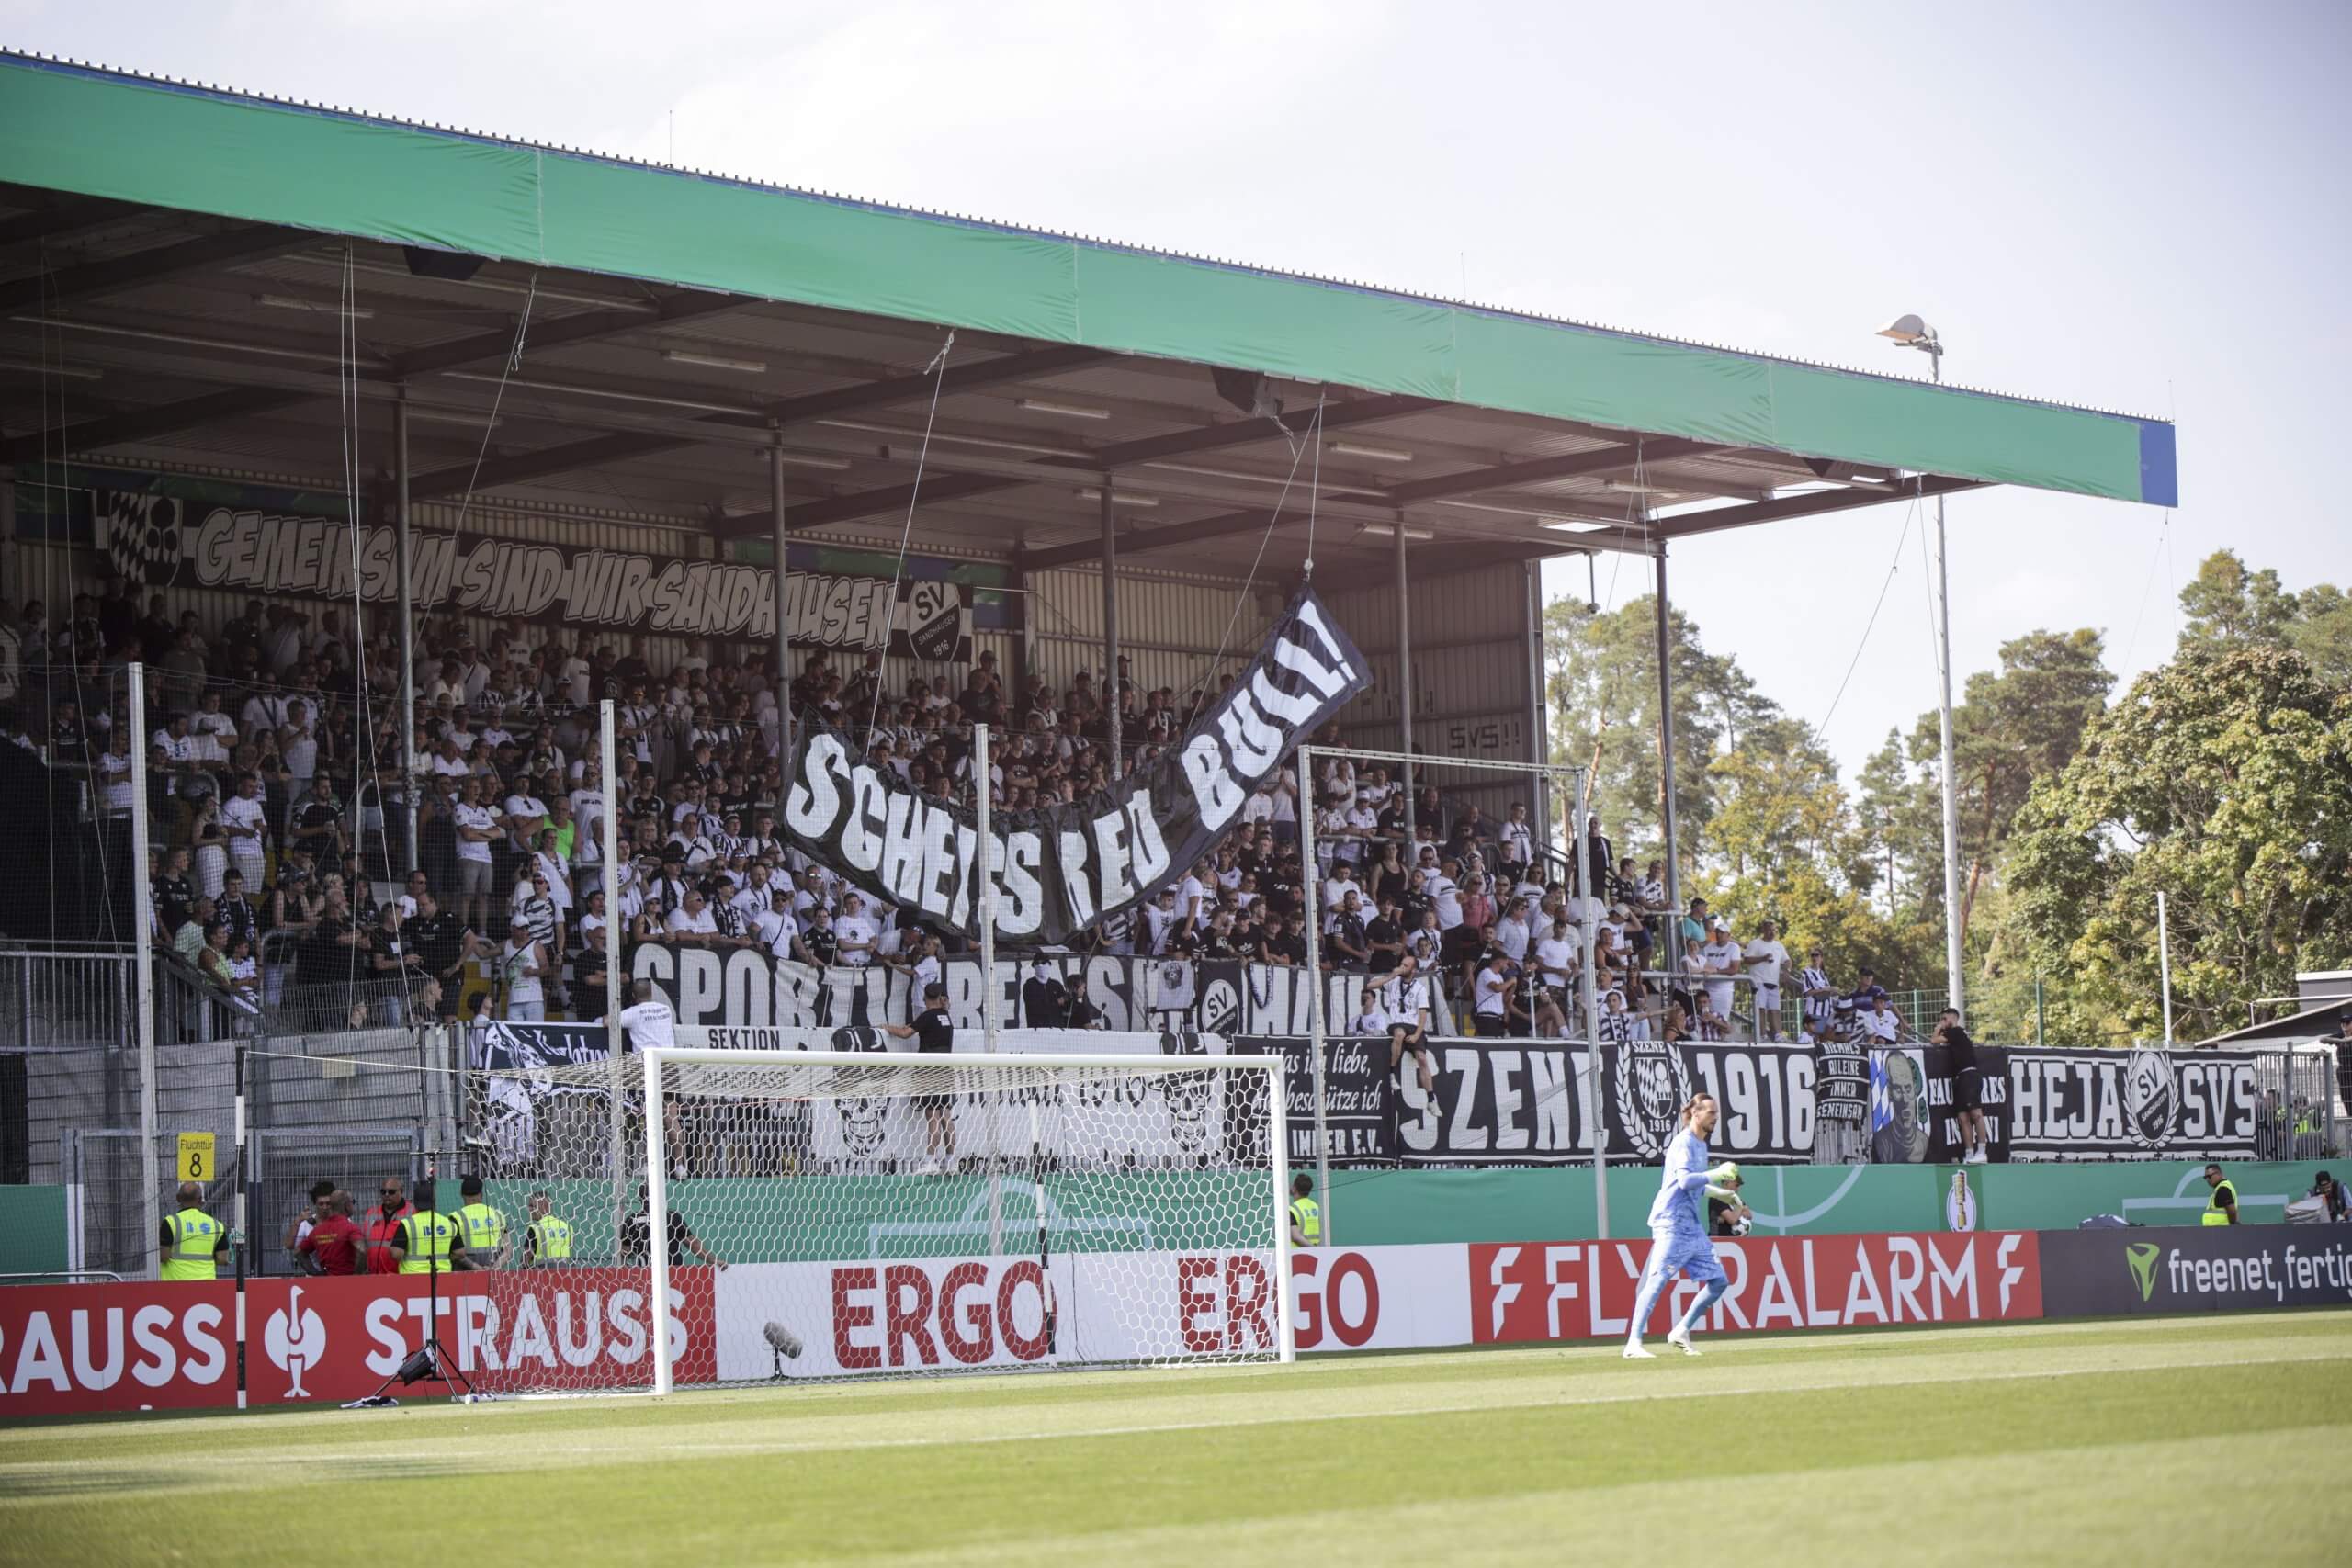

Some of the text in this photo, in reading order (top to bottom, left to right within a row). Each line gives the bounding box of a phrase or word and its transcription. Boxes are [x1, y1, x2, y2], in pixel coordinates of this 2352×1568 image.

[196, 508, 899, 651] GEMEINSAM SIND WIR SANDHAUSEN
[915, 582, 944, 621] SV
[786, 600, 1357, 934] SCHEISS RED BULL!
[1208, 987, 1227, 1018] SV
[708, 1028, 780, 1050] SEKTION
[1631, 1040, 1667, 1054] SZENE
[1332, 1043, 1371, 1077] liebe,
[1828, 1061, 1860, 1077] ALLEINE
[1286, 1080, 1359, 1111] bescütze
[1362, 1080, 1383, 1111] ich
[1830, 1082, 1857, 1098] IMMER
[2138, 1061, 2158, 1100] SV
[1400, 1049, 1816, 1151] SZENE 1916
[1815, 1104, 1863, 1120] GEMEINSAM
[2010, 1060, 2256, 1139] HEJA SVS
[1352, 1129, 1383, 1155] E.V.
[1649, 1119, 1672, 1133] 1916
[180, 1138, 213, 1150] Fluchttür
[189, 1152, 202, 1178] 8
[2168, 1248, 2284, 1302] freenet,
[831, 1260, 1057, 1369] ERGO
[1178, 1253, 1379, 1352] ERGO
[0, 1303, 227, 1394] AUSS
[366, 1287, 687, 1378] STRAUSS
